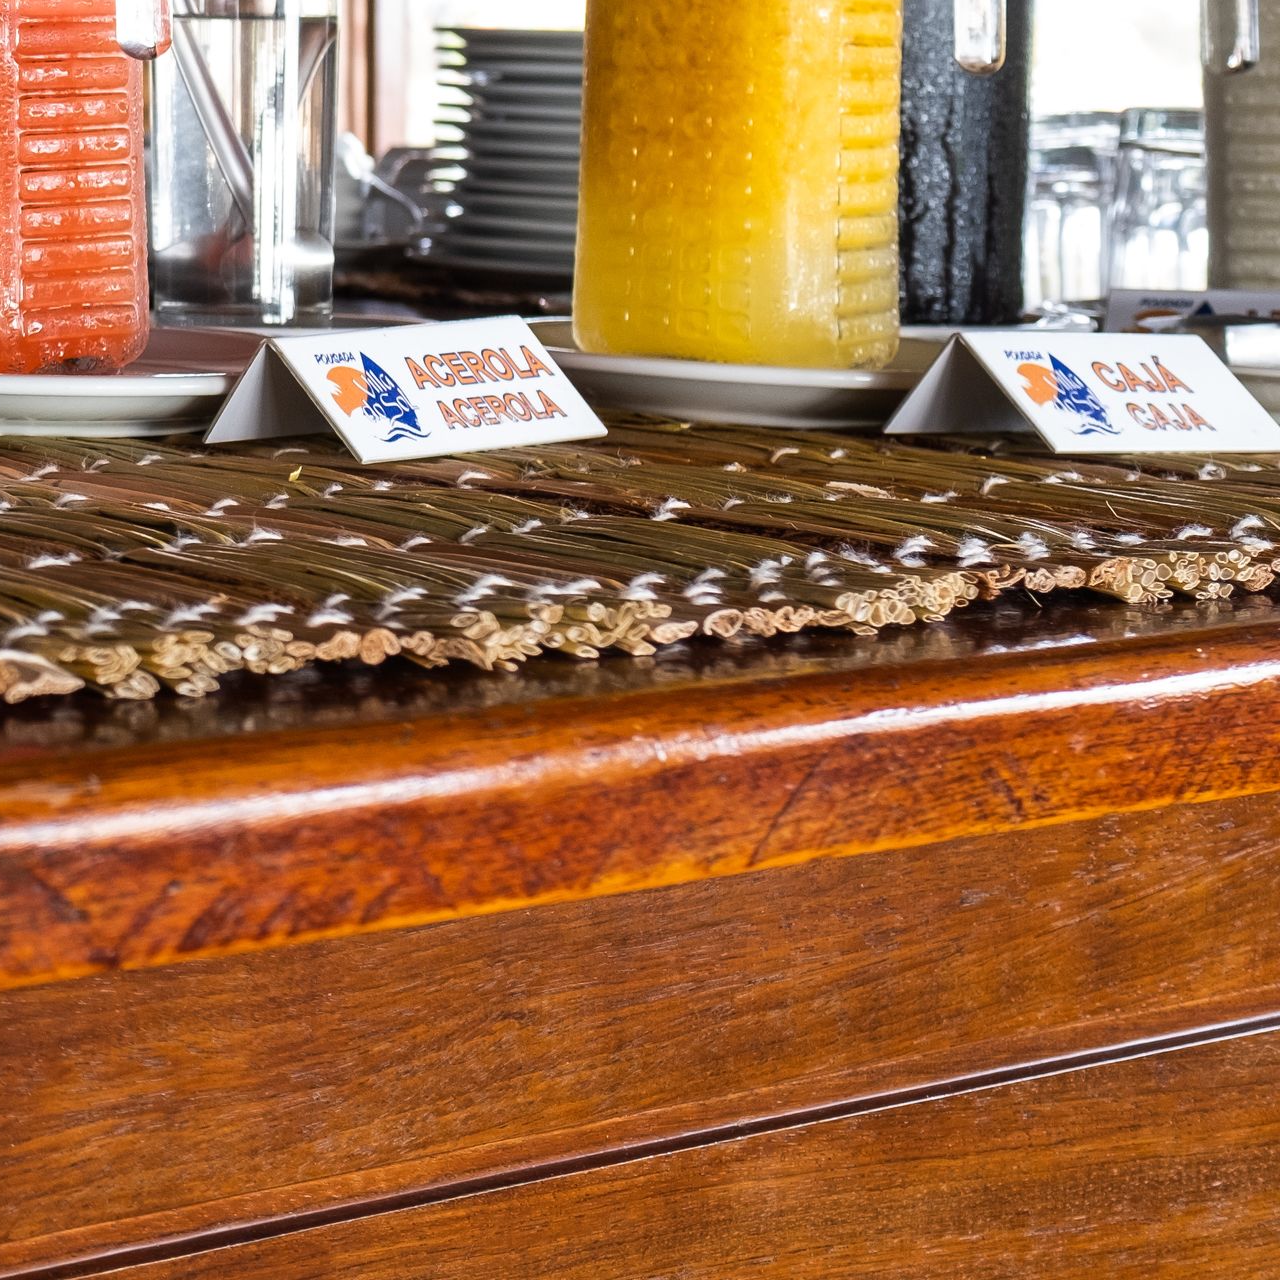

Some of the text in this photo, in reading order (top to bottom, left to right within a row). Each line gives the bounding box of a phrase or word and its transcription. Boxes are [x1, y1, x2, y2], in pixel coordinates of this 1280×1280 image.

[352, 370, 396, 399] Villa
[403, 344, 555, 392] ACEROLA
[1090, 355, 1195, 394] CAJÁ
[436, 389, 568, 431] ACEROLA
[1125, 402, 1218, 432] CAJA
